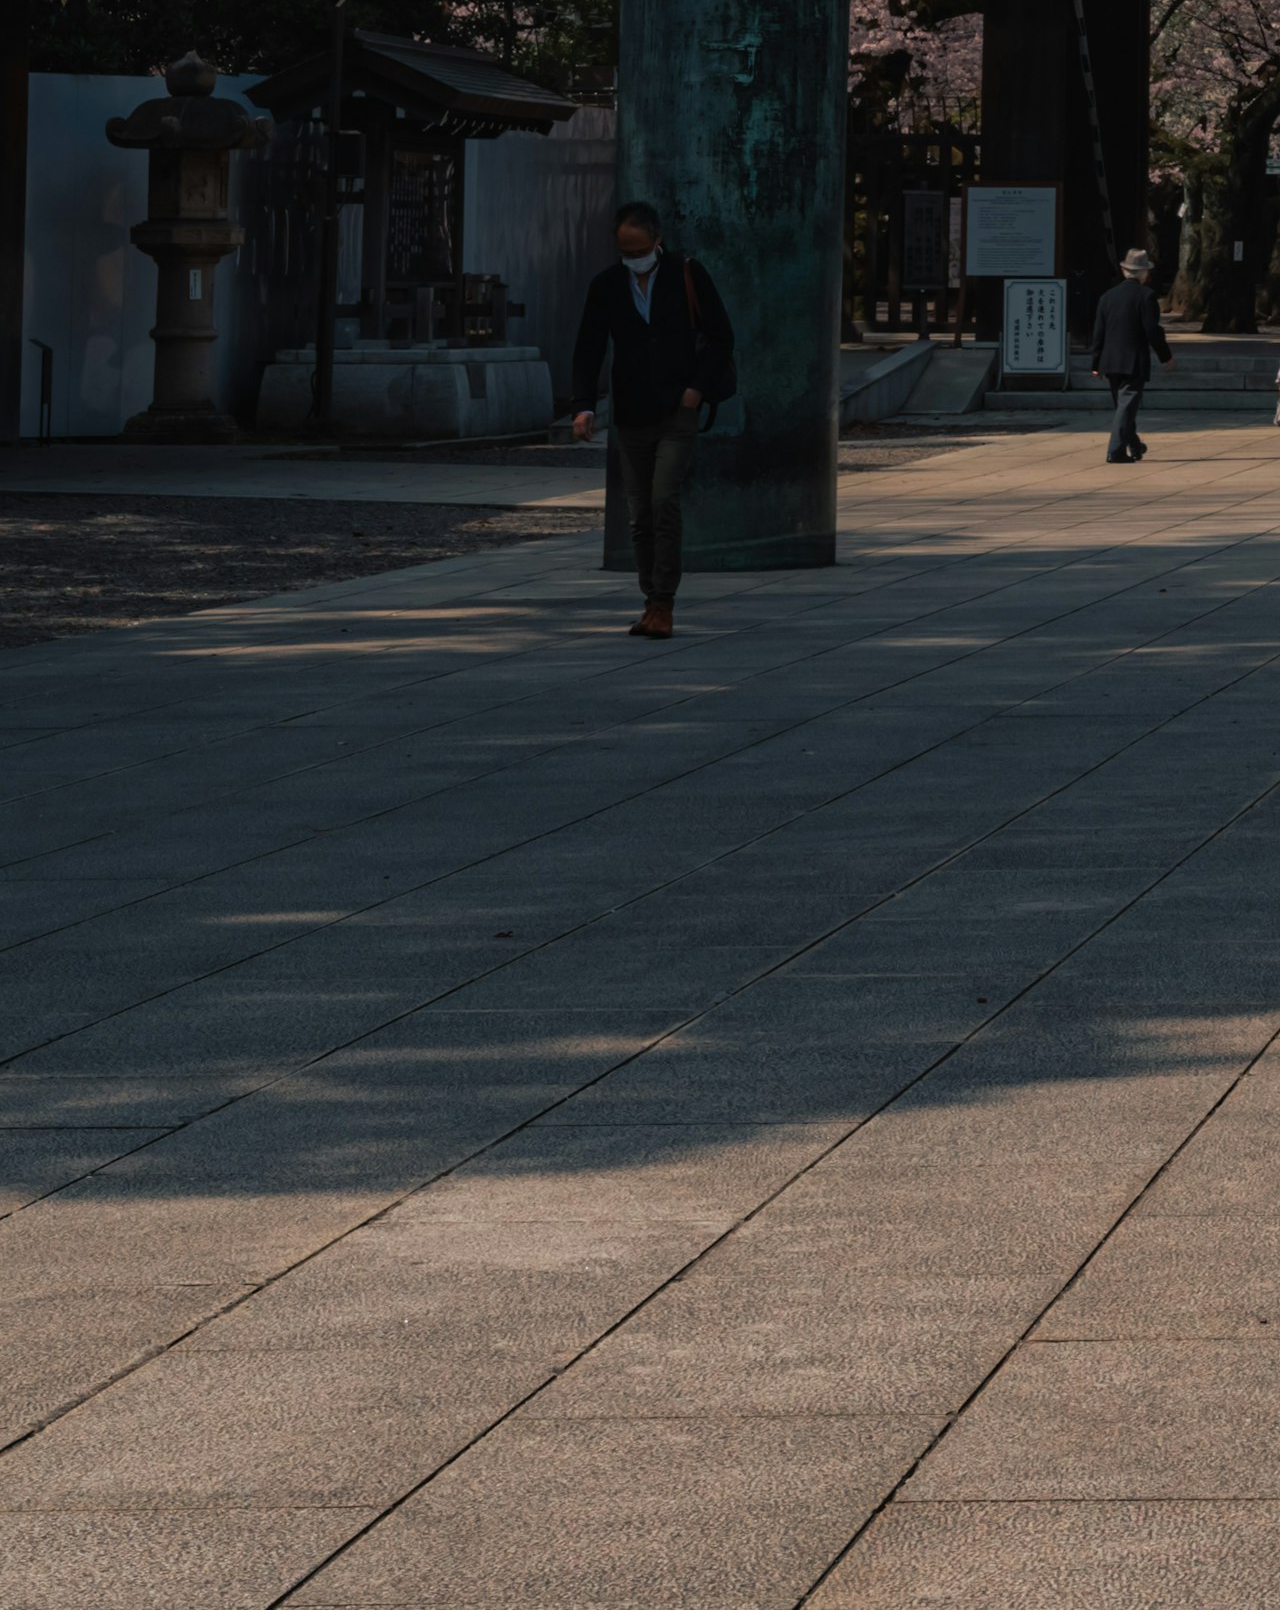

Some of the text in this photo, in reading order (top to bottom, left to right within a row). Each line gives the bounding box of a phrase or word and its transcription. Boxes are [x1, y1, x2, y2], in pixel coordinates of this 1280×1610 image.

[1049, 289, 1057, 330] これより先
